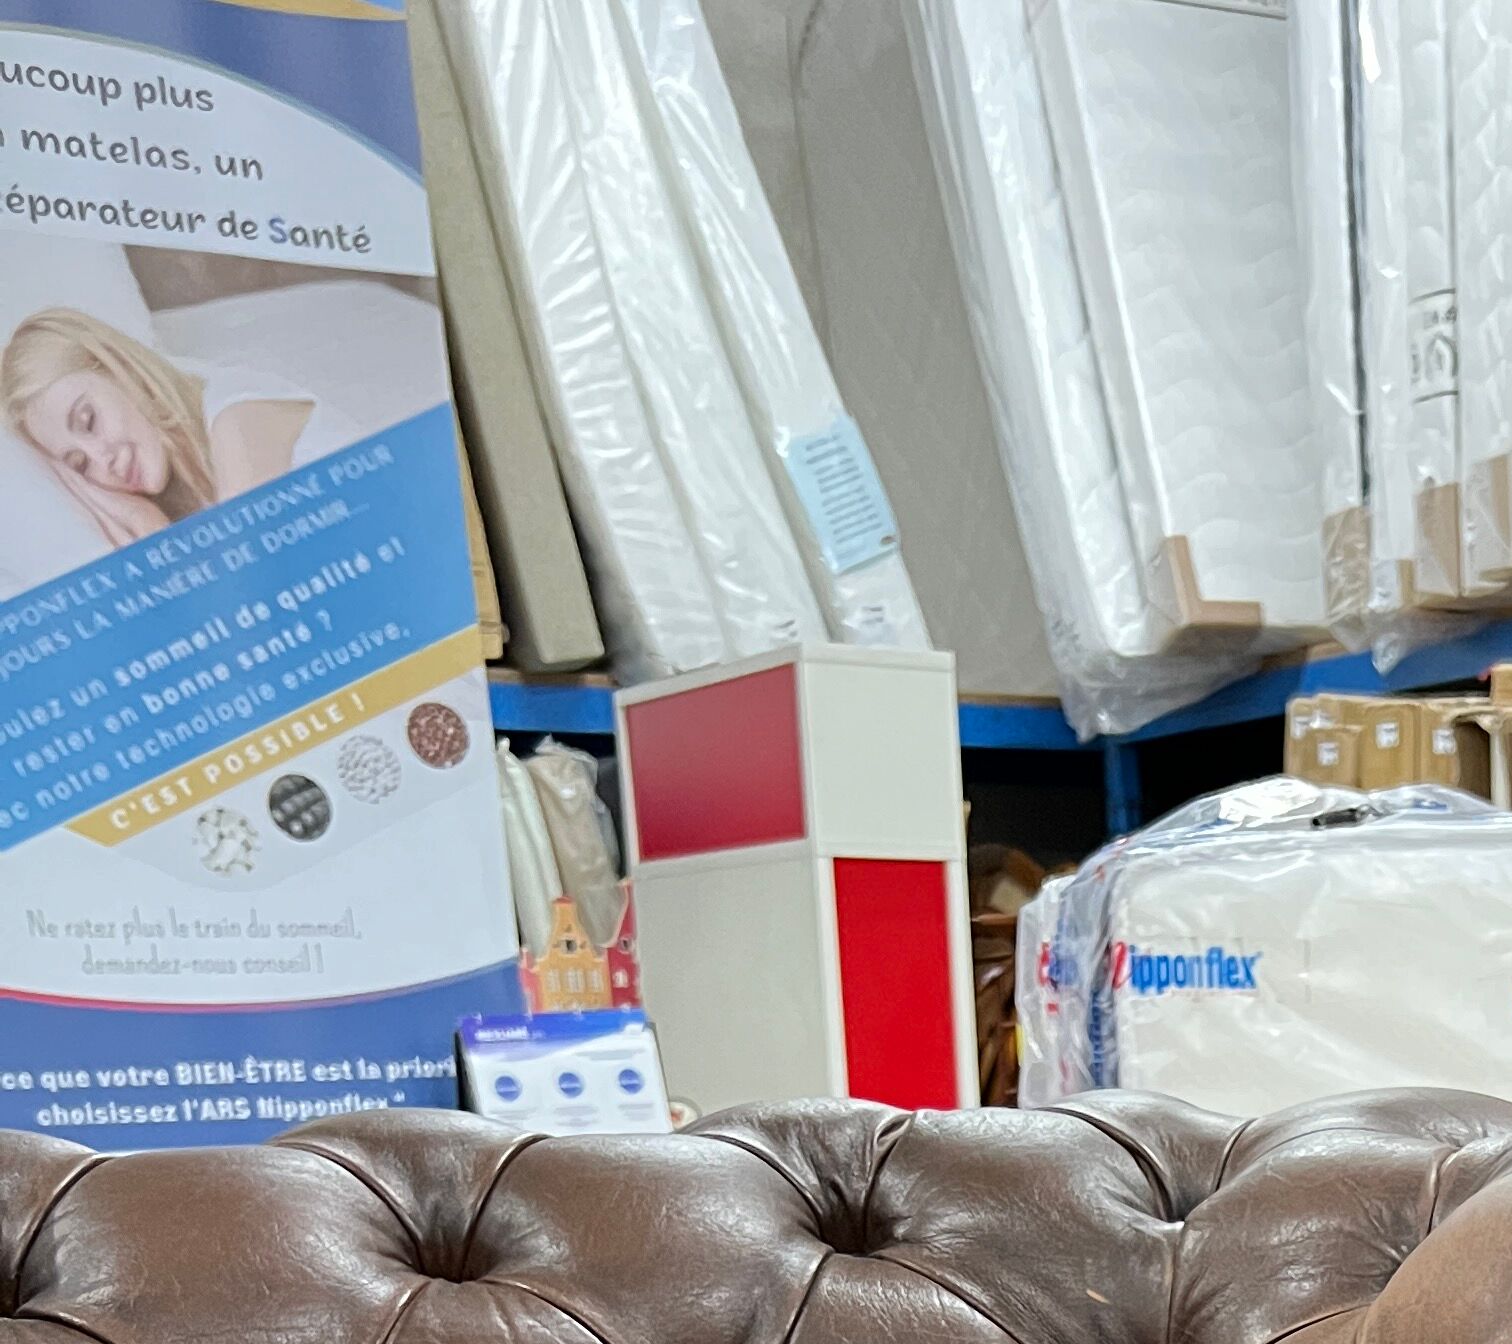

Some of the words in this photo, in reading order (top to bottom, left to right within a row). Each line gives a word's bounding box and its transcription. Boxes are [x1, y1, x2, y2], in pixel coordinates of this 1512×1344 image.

[0, 60, 122, 106] ucoup
[133, 75, 215, 112] plus
[20, 128, 202, 174] matelas,
[214, 153, 264, 180] un
[217, 210, 258, 240] de
[269, 216, 372, 254] Santé
[124, 560, 144, 582] A
[328, 443, 395, 488] POUR
[72, 610, 113, 640] LA
[221, 541, 259, 572] DE
[69, 679, 109, 707] un
[113, 616, 232, 688] sommeil
[235, 601, 271, 630] de
[276, 550, 372, 613] qualité
[376, 535, 406, 564] et
[12, 703, 97, 778] rester
[103, 706, 140, 735] en
[140, 662, 231, 715] bonne
[236, 621, 313, 671] santé
[316, 609, 333, 632] ?
[36, 761, 111, 809] notre
[114, 683, 277, 772] technologie
[281, 621, 412, 691] exclusive.
[110, 775, 193, 830] C'EST
[203, 703, 345, 784] POSSIBLE
[351, 691, 366, 712] !
[26, 909, 58, 939] Ne
[64, 917, 116, 939] ratez
[122, 906, 166, 946] plus
[169, 906, 189, 938] le
[194, 916, 242, 938] train
[246, 908, 271, 939] du
[277, 906, 362, 940] sommeil,
[81, 944, 237, 976] demandez-nous
[40, 1070, 91, 1093] que
[96, 1066, 170, 1088] votre
[174, 1054, 307, 1086] BIEN-ÊTRE
[312, 1060, 354, 1081] est
[356, 1057, 382, 1080] la
[36, 1101, 179, 1127] choisissez
[181, 1097, 251, 1122] l'ARS
